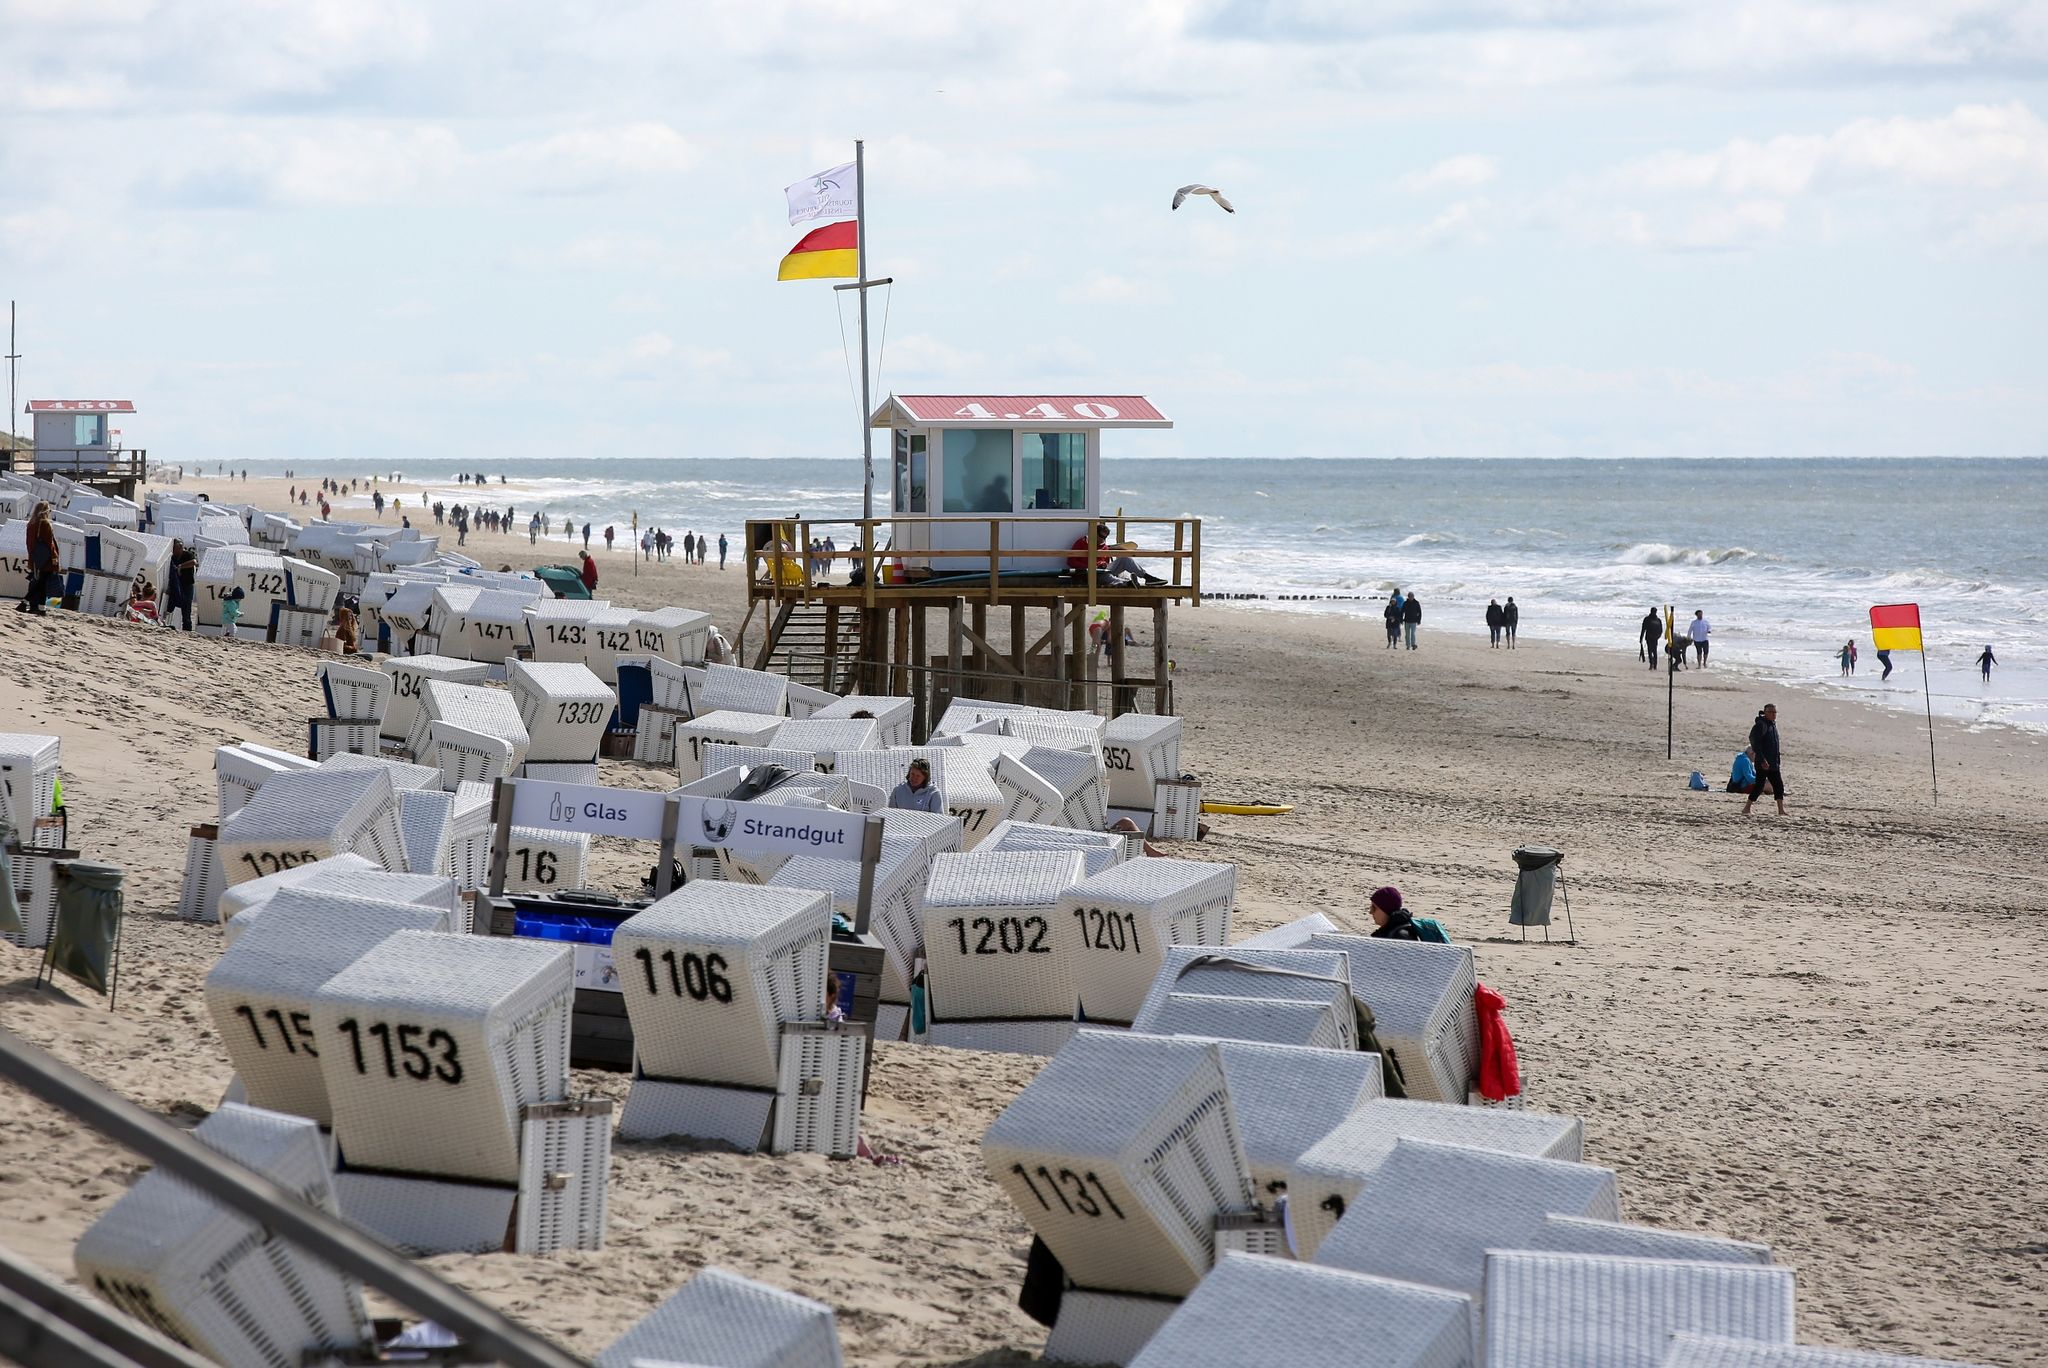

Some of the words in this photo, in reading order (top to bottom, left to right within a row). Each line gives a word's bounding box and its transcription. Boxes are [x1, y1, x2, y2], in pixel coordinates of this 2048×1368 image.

[48, 401, 117, 410] 4.50
[954, 402, 1120, 419] 4.40
[248, 573, 287, 594] 142
[475, 622, 514, 641] 1471
[597, 630, 632, 652] 142
[635, 628, 665, 653] 1421
[391, 669, 431, 701] 134
[557, 702, 604, 724] 1330
[583, 802, 627, 821] Glas
[743, 818, 845, 846] Strandgut
[948, 915, 1051, 955] 1202
[1073, 906, 1141, 954] 1201
[635, 947, 733, 1004] 1106
[235, 1004, 319, 1059] 115
[338, 1017, 463, 1085] 1153
[1010, 1162, 1126, 1221] 1131
